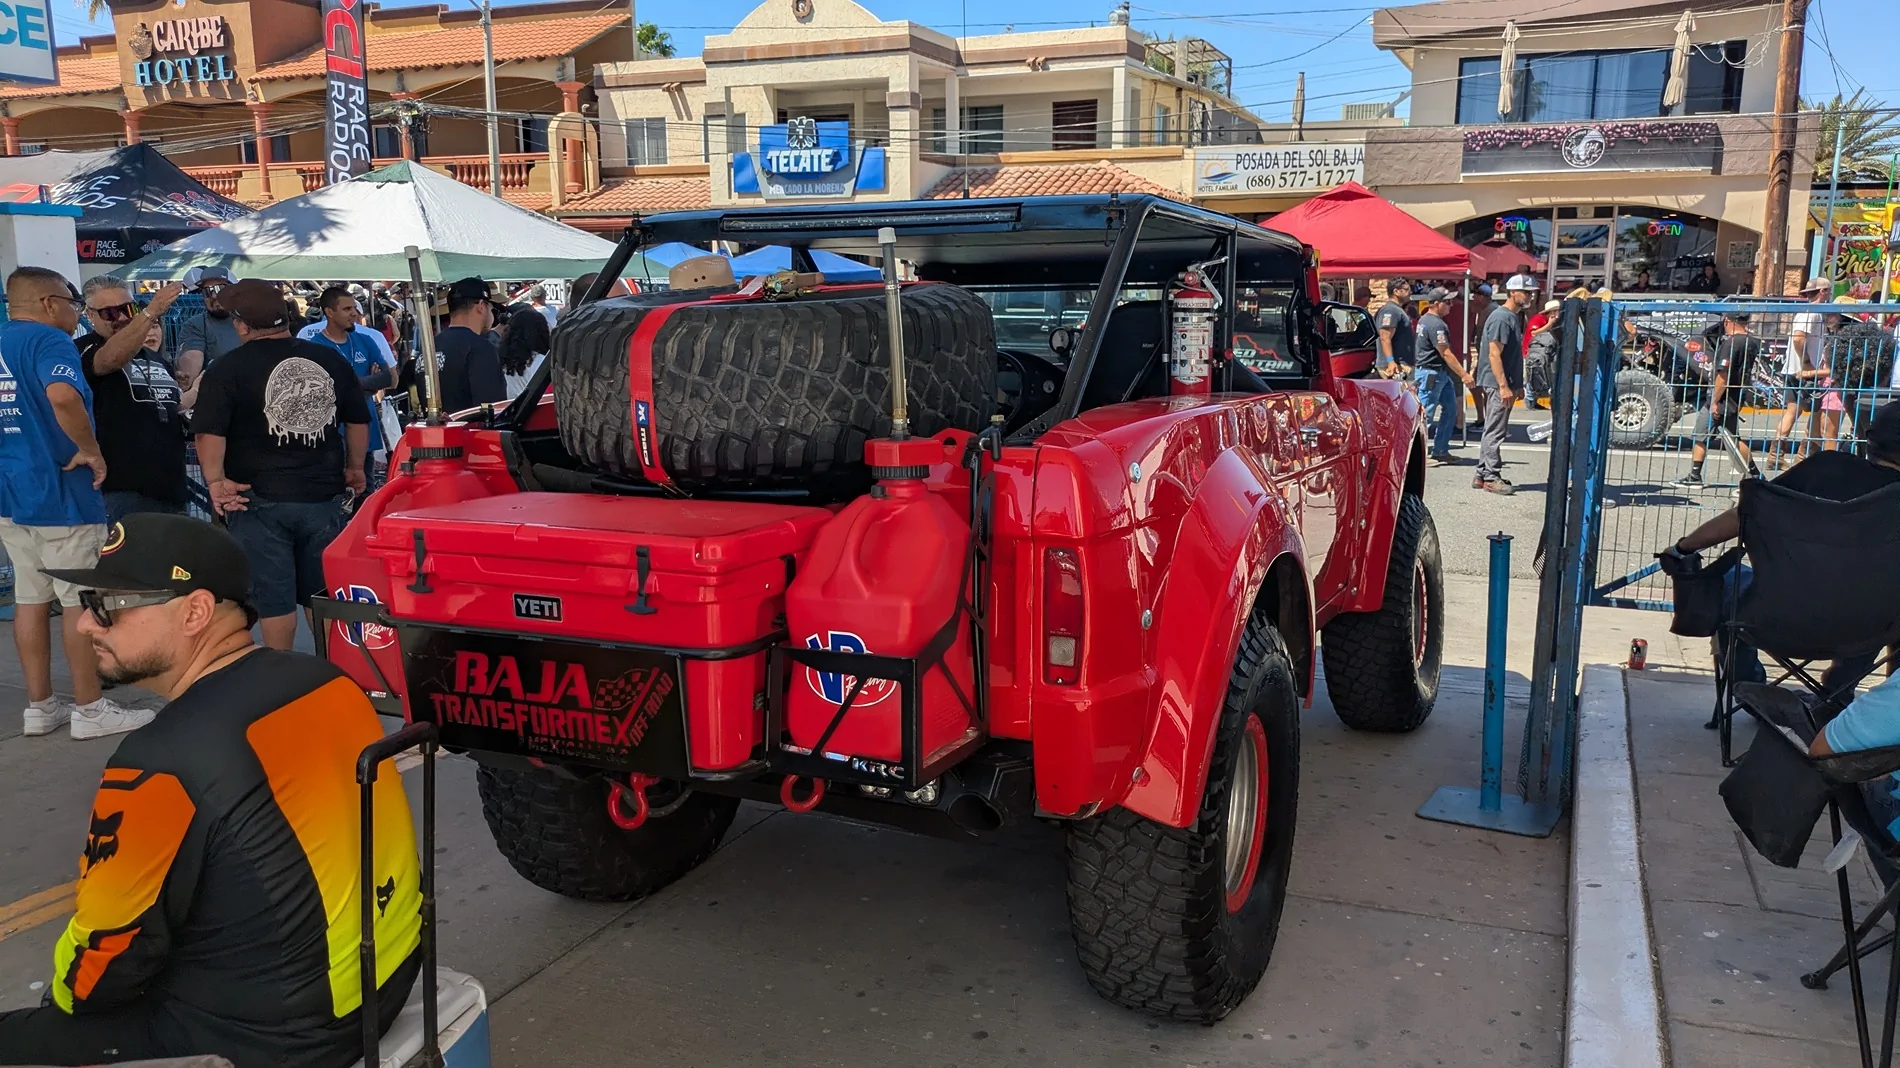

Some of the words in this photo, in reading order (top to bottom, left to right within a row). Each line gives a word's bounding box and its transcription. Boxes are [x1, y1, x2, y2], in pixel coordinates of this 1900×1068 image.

[153, 16, 224, 55] CARIBE
[325, 0, 363, 79] CI
[132, 55, 234, 86] HOTEL
[329, 80, 352, 186] RADIOS
[349, 84, 371, 163] RACE
[767, 149, 834, 173] TECATE
[1236, 152, 1279, 171] POSADA
[1283, 150, 1304, 169] DEL
[1309, 149, 1329, 167] SOL
[1333, 147, 1364, 166] BAJA
[769, 184, 802, 195] MERCADO
[804, 183, 813, 194] LA
[815, 182, 845, 193] MORENA
[1198, 185, 1214, 193] HOTEL
[1215, 184, 1238, 192] FAMILIAR
[1246, 174, 1275, 190] (686)
[1279, 169, 1355, 188] 577-1727
[1495, 220, 1526, 232] OPEN
[1648, 222, 1682, 236] OPEN
[96, 249, 125, 258] RADIOS
[97, 241, 117, 249] RACE
[1240, 359, 1294, 370] NTAIN
[516, 598, 558, 617] YETI
[454, 651, 593, 708] BAJA
[429, 692, 631, 747] TRANSFORMEX
[630, 712, 649, 747] OFF
[644, 672, 674, 719] ROAD
